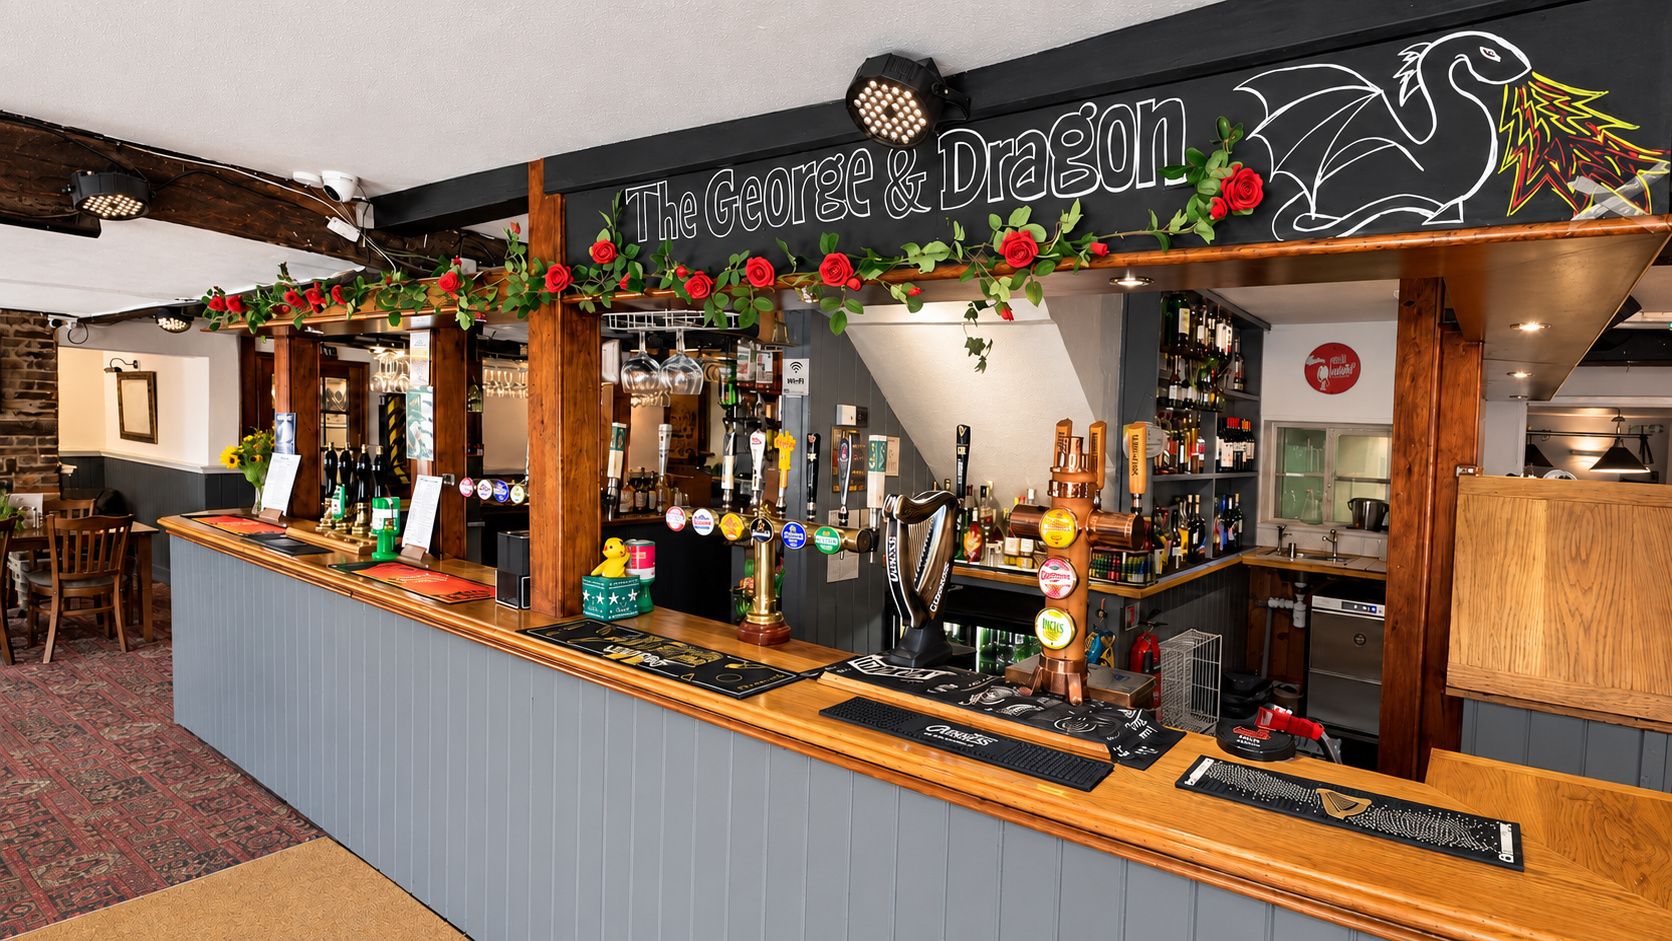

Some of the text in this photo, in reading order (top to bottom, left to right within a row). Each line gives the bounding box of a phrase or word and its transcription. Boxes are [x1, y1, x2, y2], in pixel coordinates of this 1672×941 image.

[625, 97, 1188, 243] The George & Dragon
